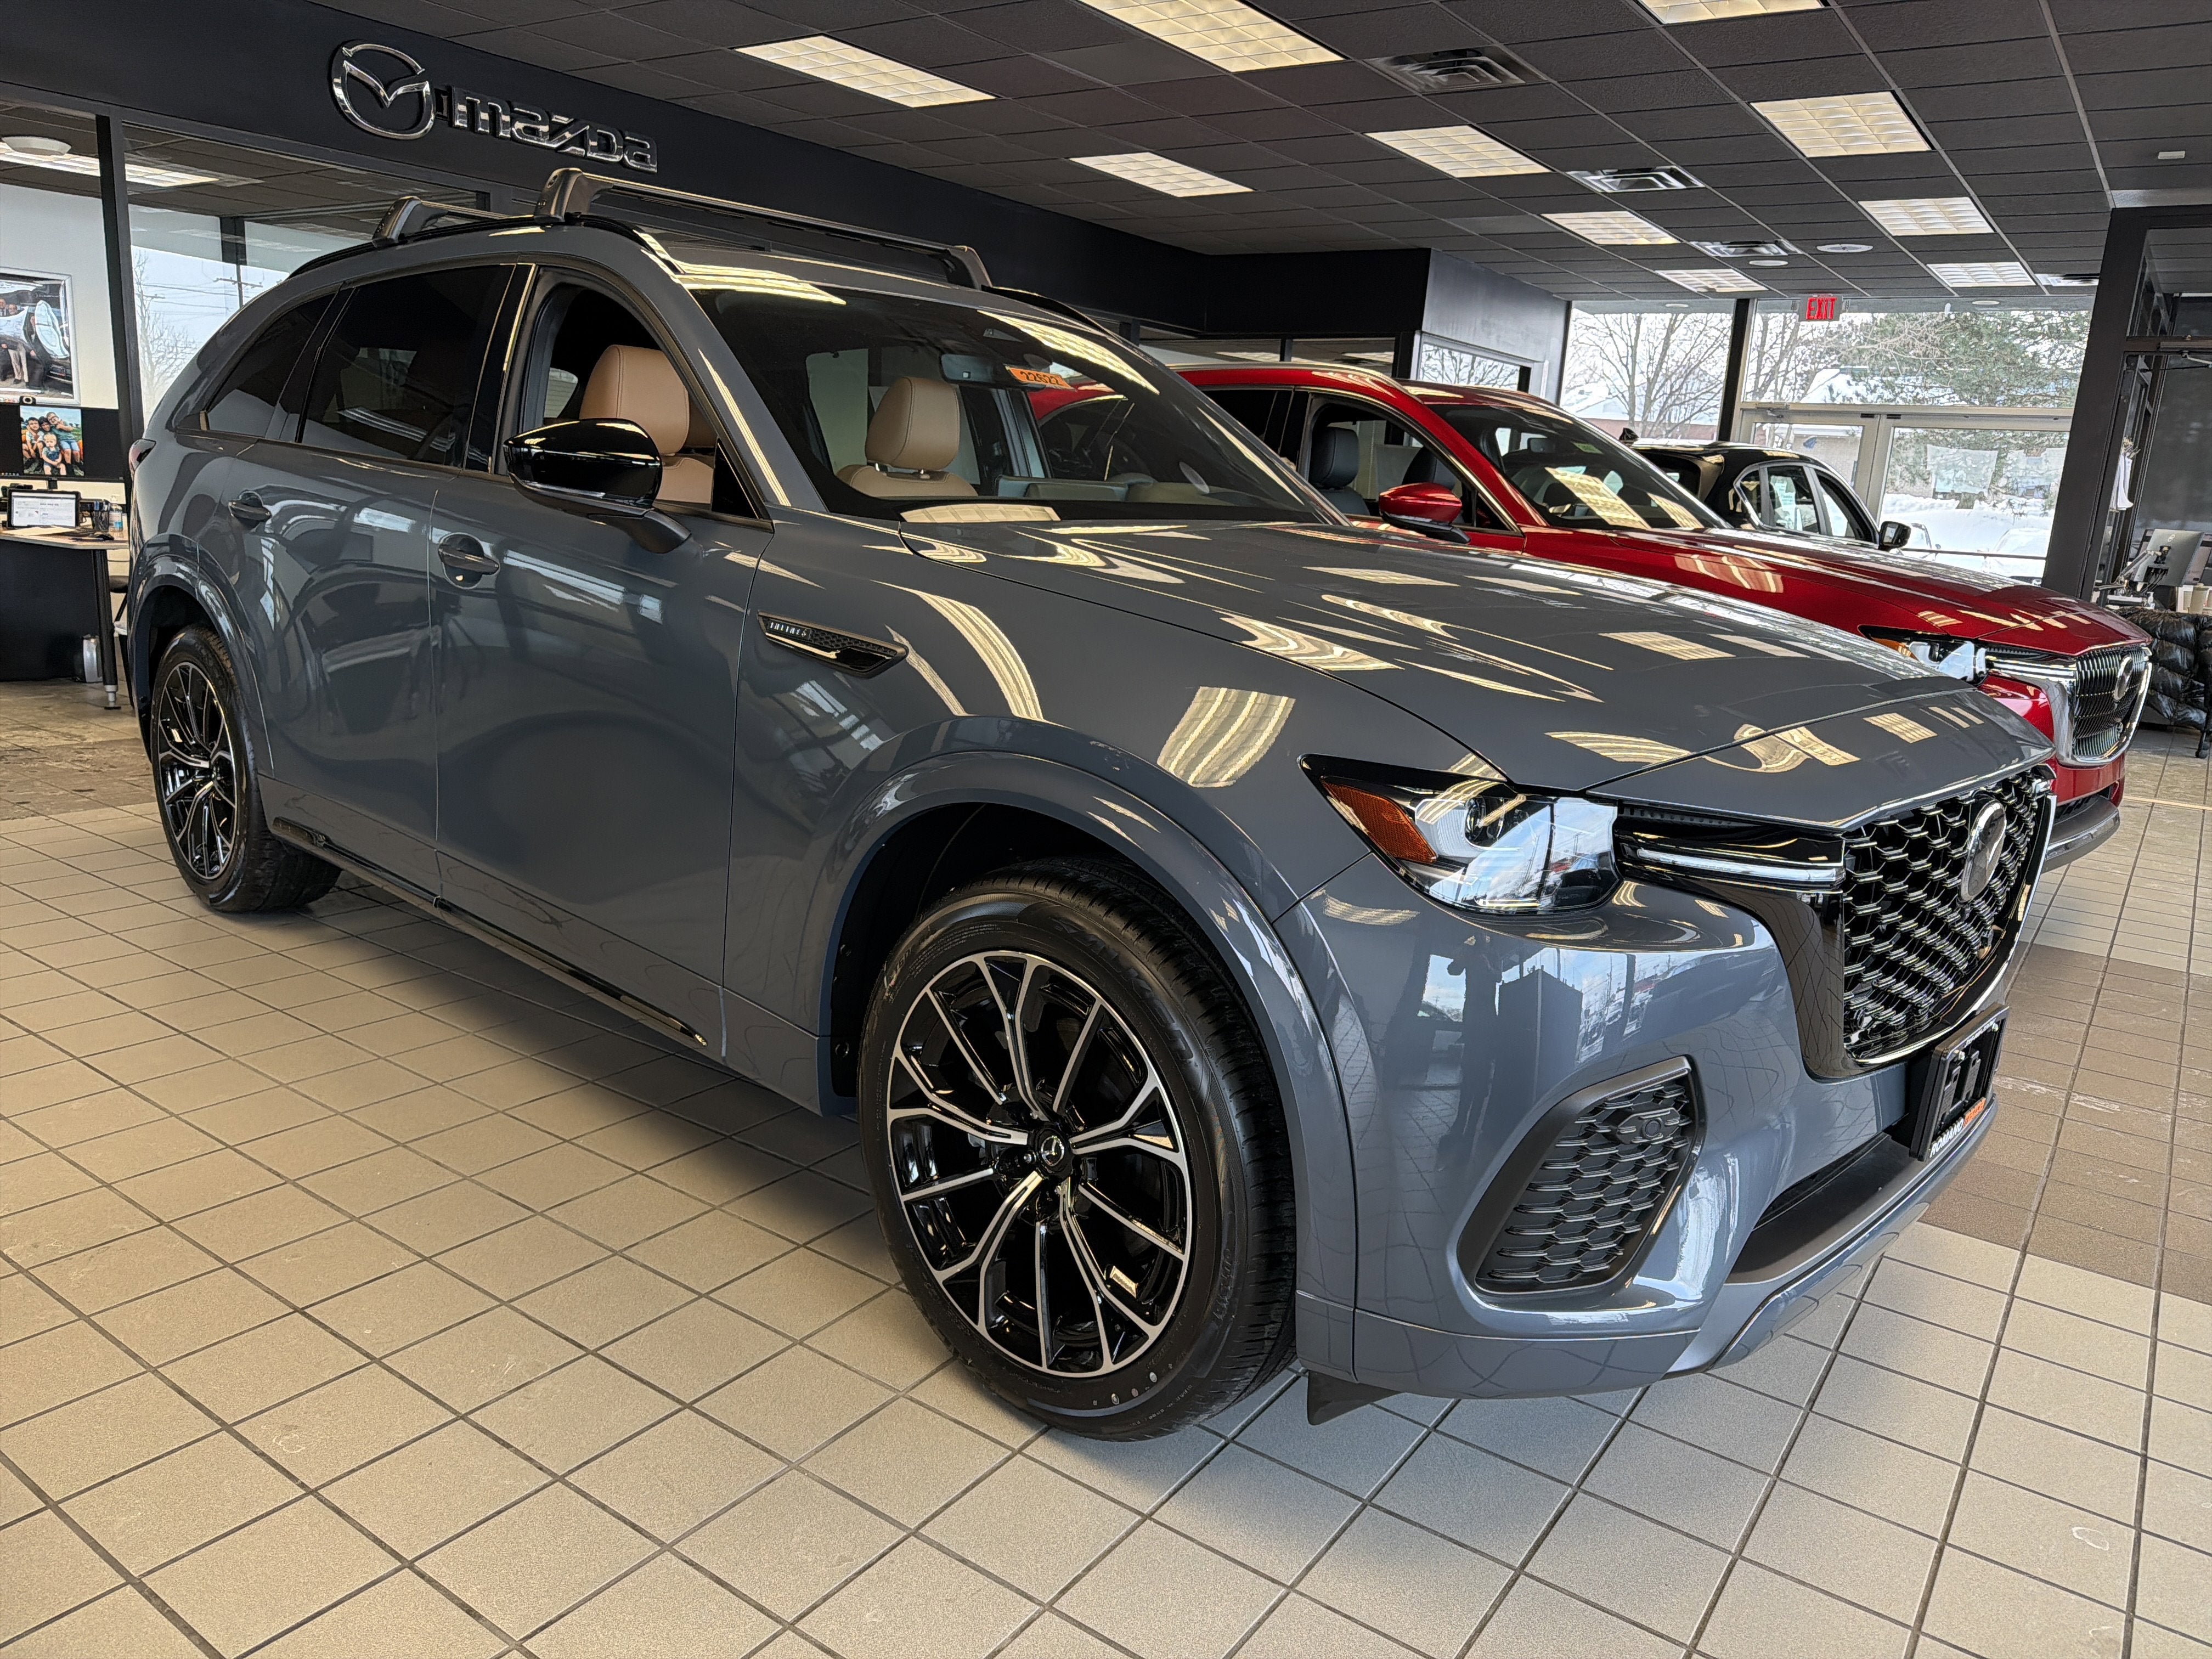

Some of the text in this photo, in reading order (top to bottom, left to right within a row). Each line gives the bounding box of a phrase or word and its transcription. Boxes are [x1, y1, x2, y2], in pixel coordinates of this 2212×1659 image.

[1805, 297, 1837, 320] EXIT
[1020, 371, 1064, 386] 22622
[1929, 1117, 1964, 1158] ROMANO
